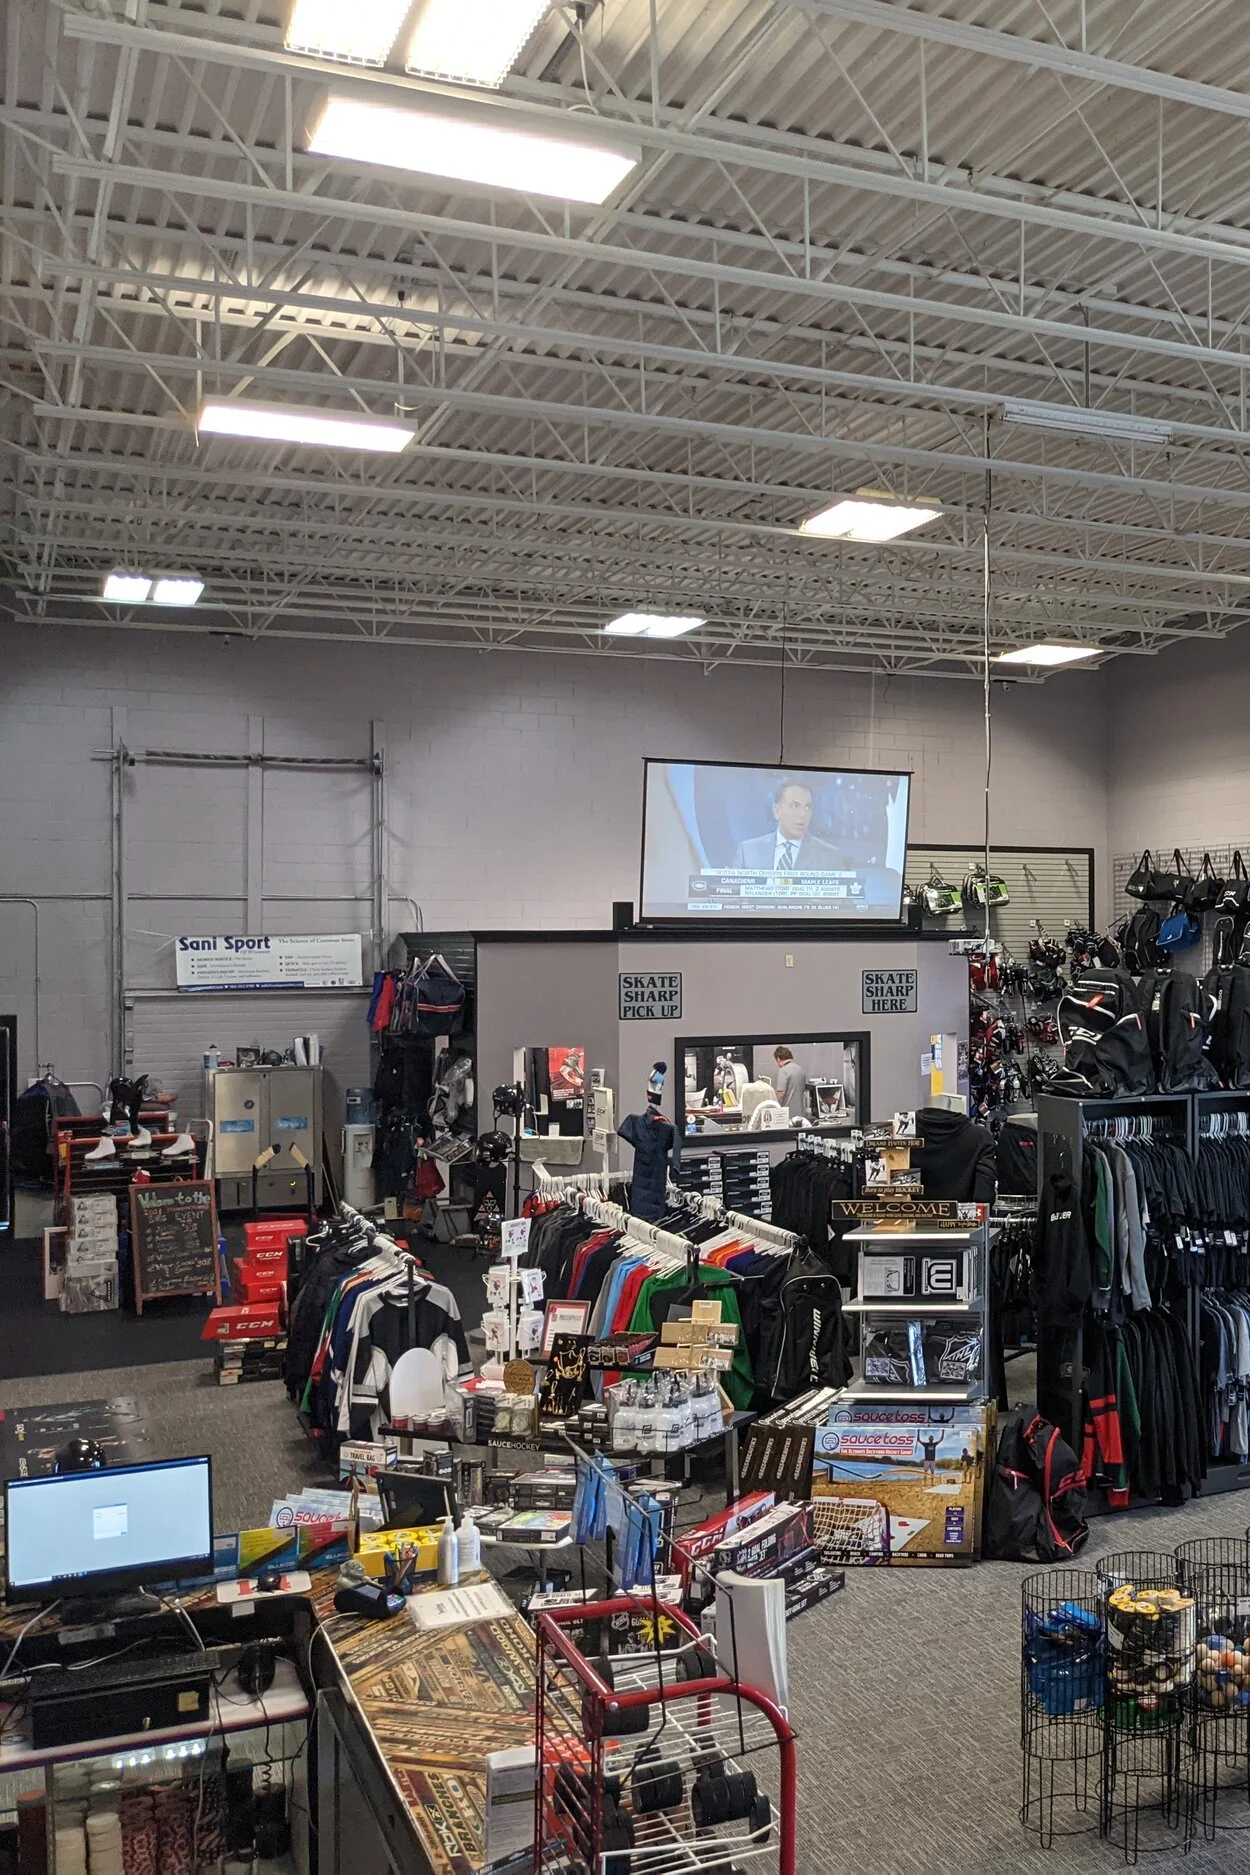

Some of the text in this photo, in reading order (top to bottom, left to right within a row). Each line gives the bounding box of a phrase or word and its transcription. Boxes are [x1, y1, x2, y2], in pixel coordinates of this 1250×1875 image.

[720, 877, 755, 885] CANADIENS
[179, 936, 271, 953] Sani Sport
[622, 976, 679, 989] SKATE
[865, 973, 914, 985] SKATE
[624, 990, 678, 1003] SHARP
[865, 985, 913, 998] SHARP
[623, 1005, 678, 1018] PICK UP
[872, 999, 908, 1011] HERE
[175, 1192, 191, 1204] to
[175, 1211, 204, 1220] EVENT
[840, 1202, 951, 1217] WELCOME
[236, 1320, 274, 1330] CCM
[349, 1452, 376, 1462] TRAVEL BAG
[691, 1527, 726, 1556] CCM
[447, 1664, 473, 1705] EASTON
[427, 1772, 479, 1856] BRANCHES
